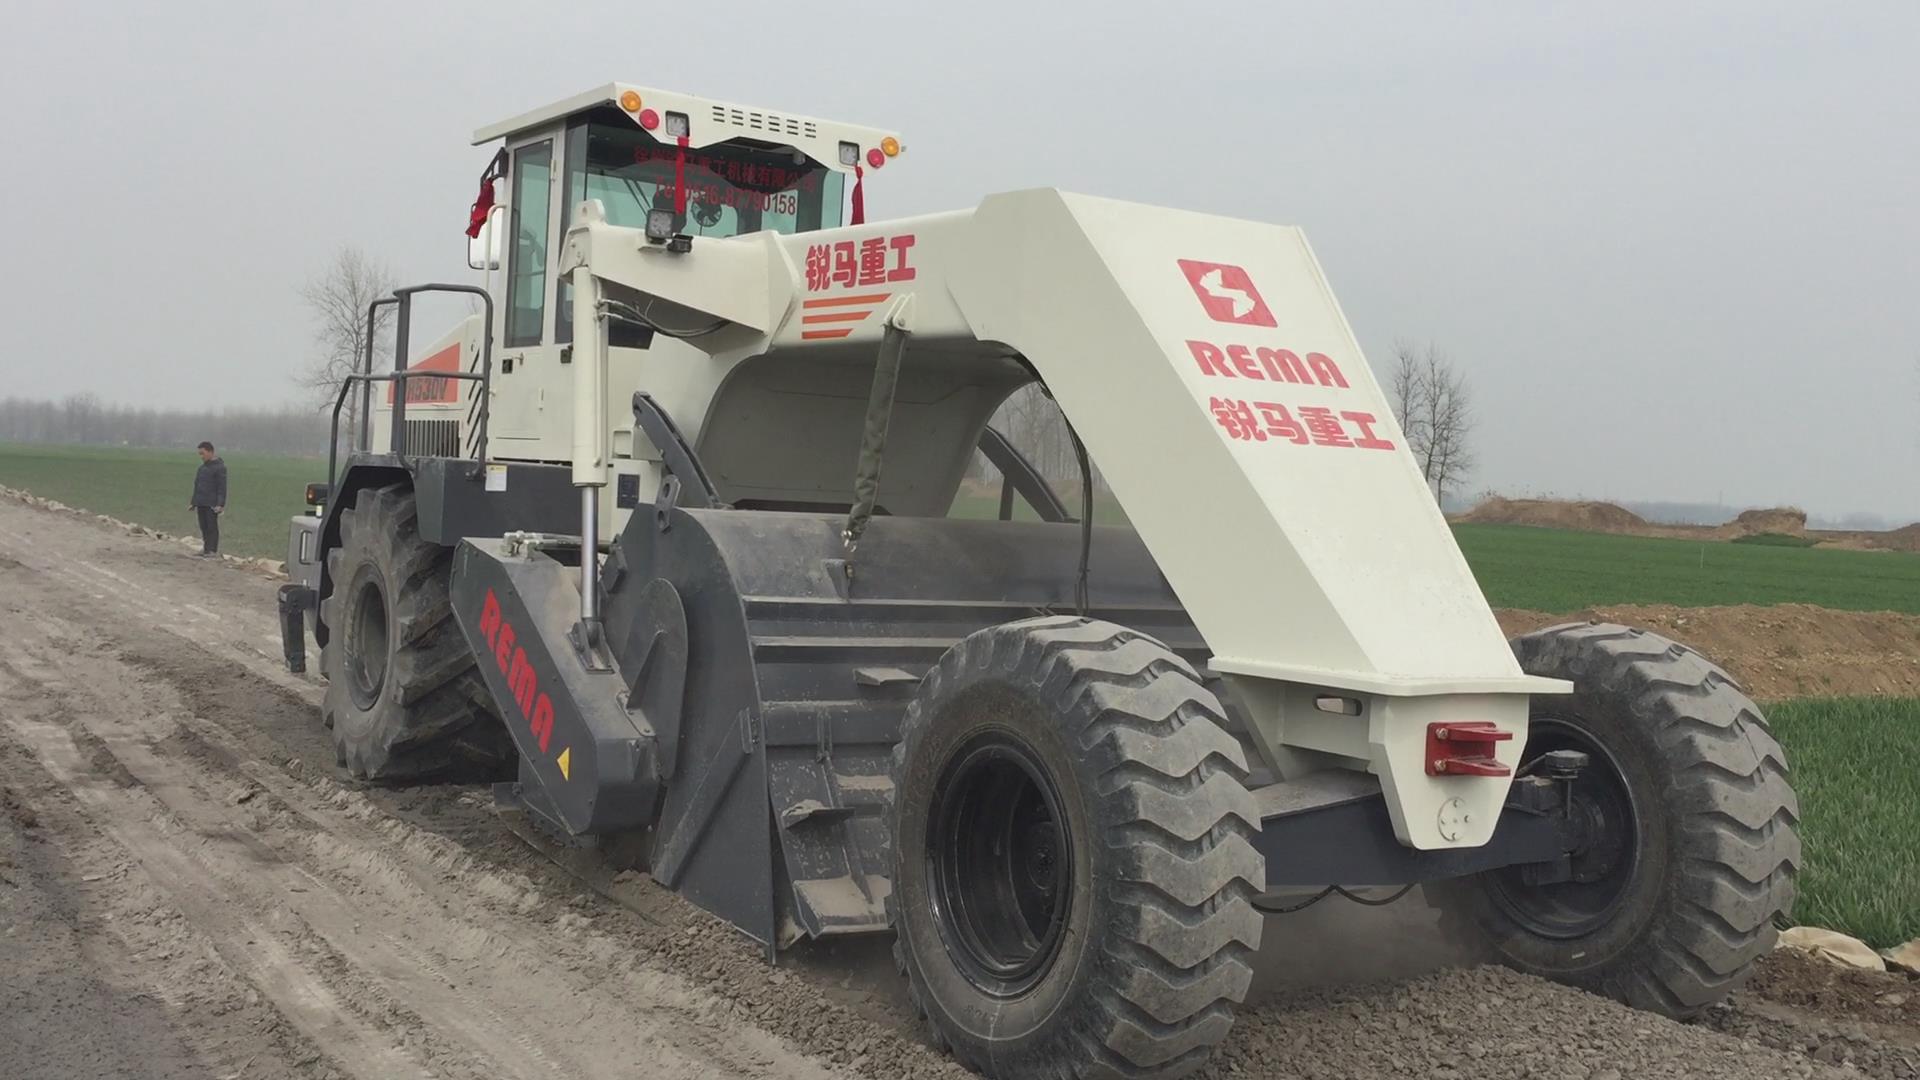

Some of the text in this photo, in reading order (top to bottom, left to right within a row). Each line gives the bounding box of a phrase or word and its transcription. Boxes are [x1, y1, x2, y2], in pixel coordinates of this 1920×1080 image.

[805, 234, 917, 291] 锐马重工
[1185, 340, 1350, 389] REMA
[1210, 396, 1396, 451] 锐马重工
[480, 587, 555, 754] REMA
